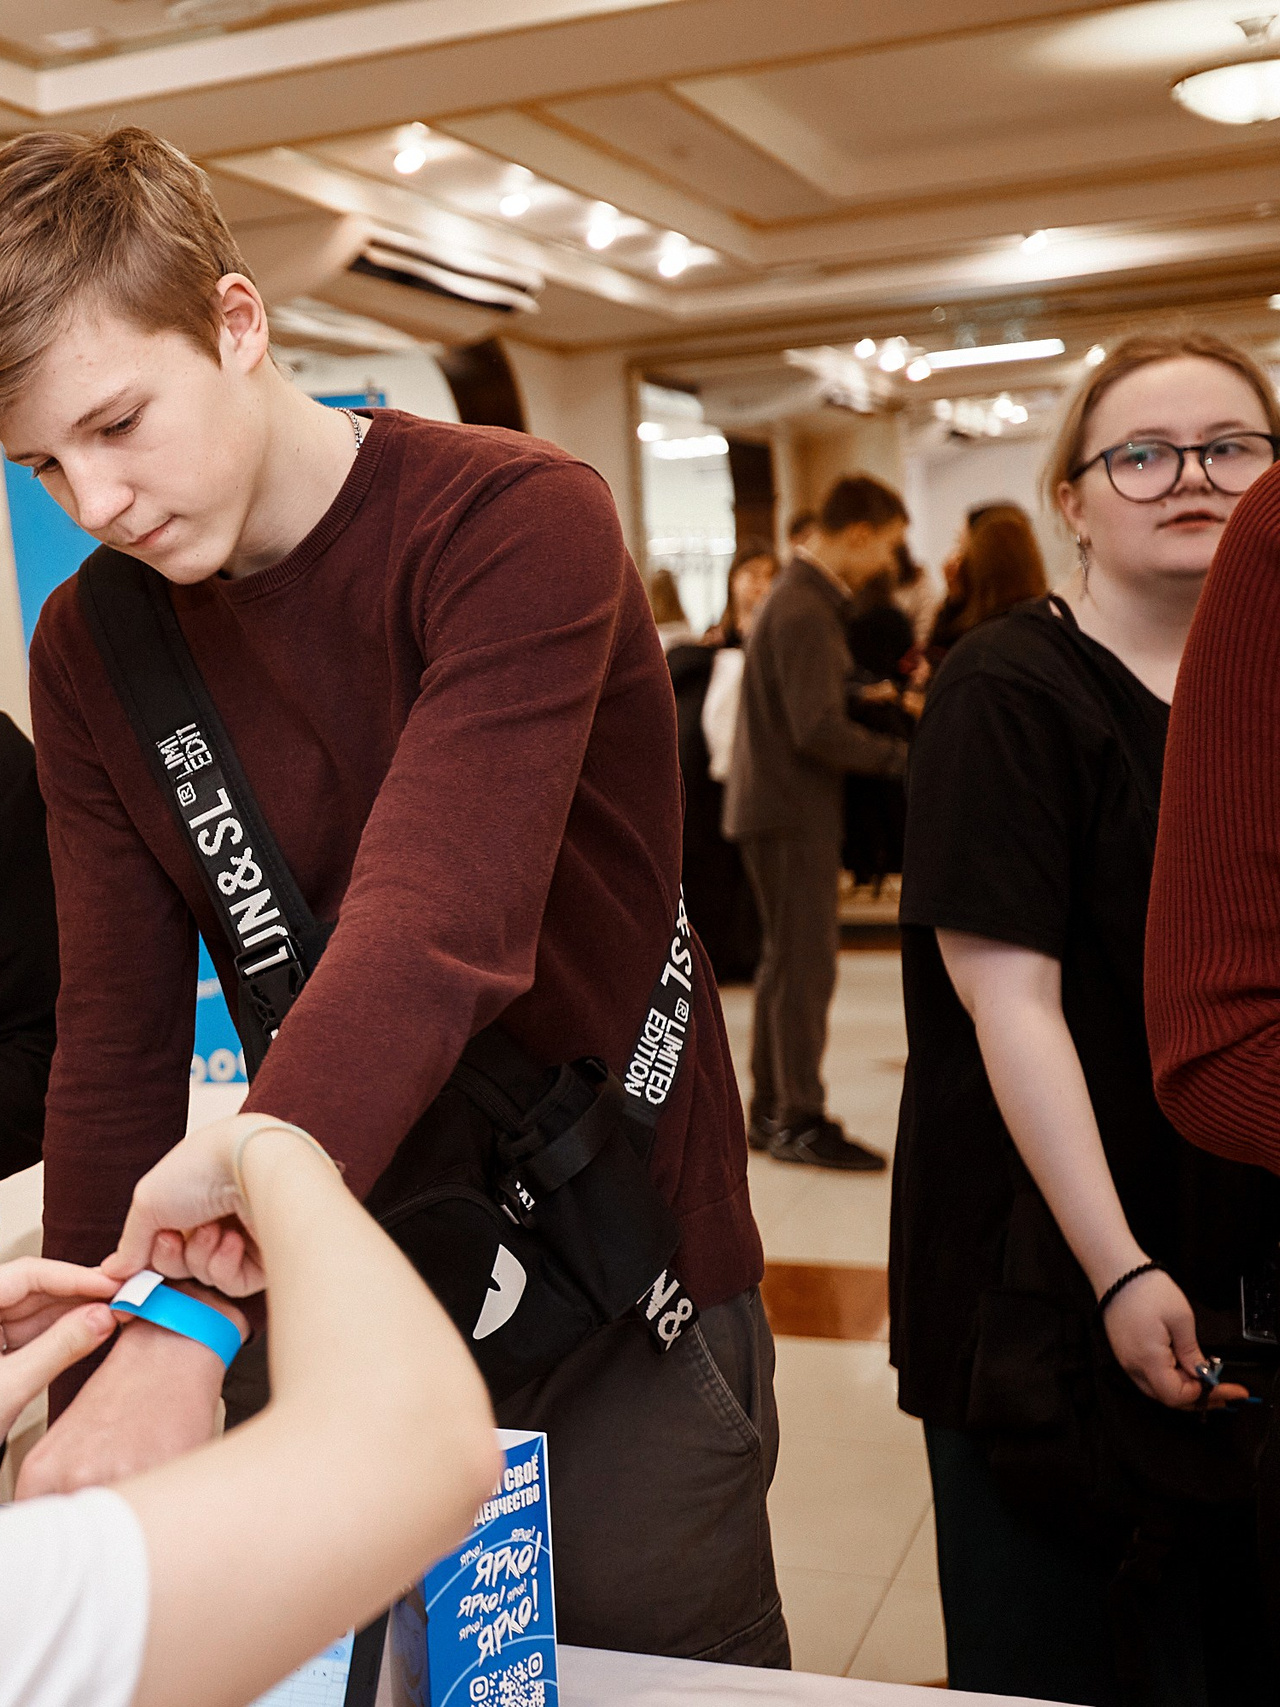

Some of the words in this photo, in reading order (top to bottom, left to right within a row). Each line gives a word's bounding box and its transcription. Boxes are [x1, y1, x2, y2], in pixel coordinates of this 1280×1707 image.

[623, 1007, 668, 1098] EDITION
[644, 1018, 687, 1106] LIMITED
[503, 1453, 540, 1492] СВОЁ
[471, 1530, 543, 1591] ЯРКО!
[456, 1584, 507, 1619] ЯРКО!
[506, 1577, 528, 1604] ЯРКО!
[459, 1614, 484, 1642] ЯРКО!
[477, 1577, 540, 1668] ЯРКО!
